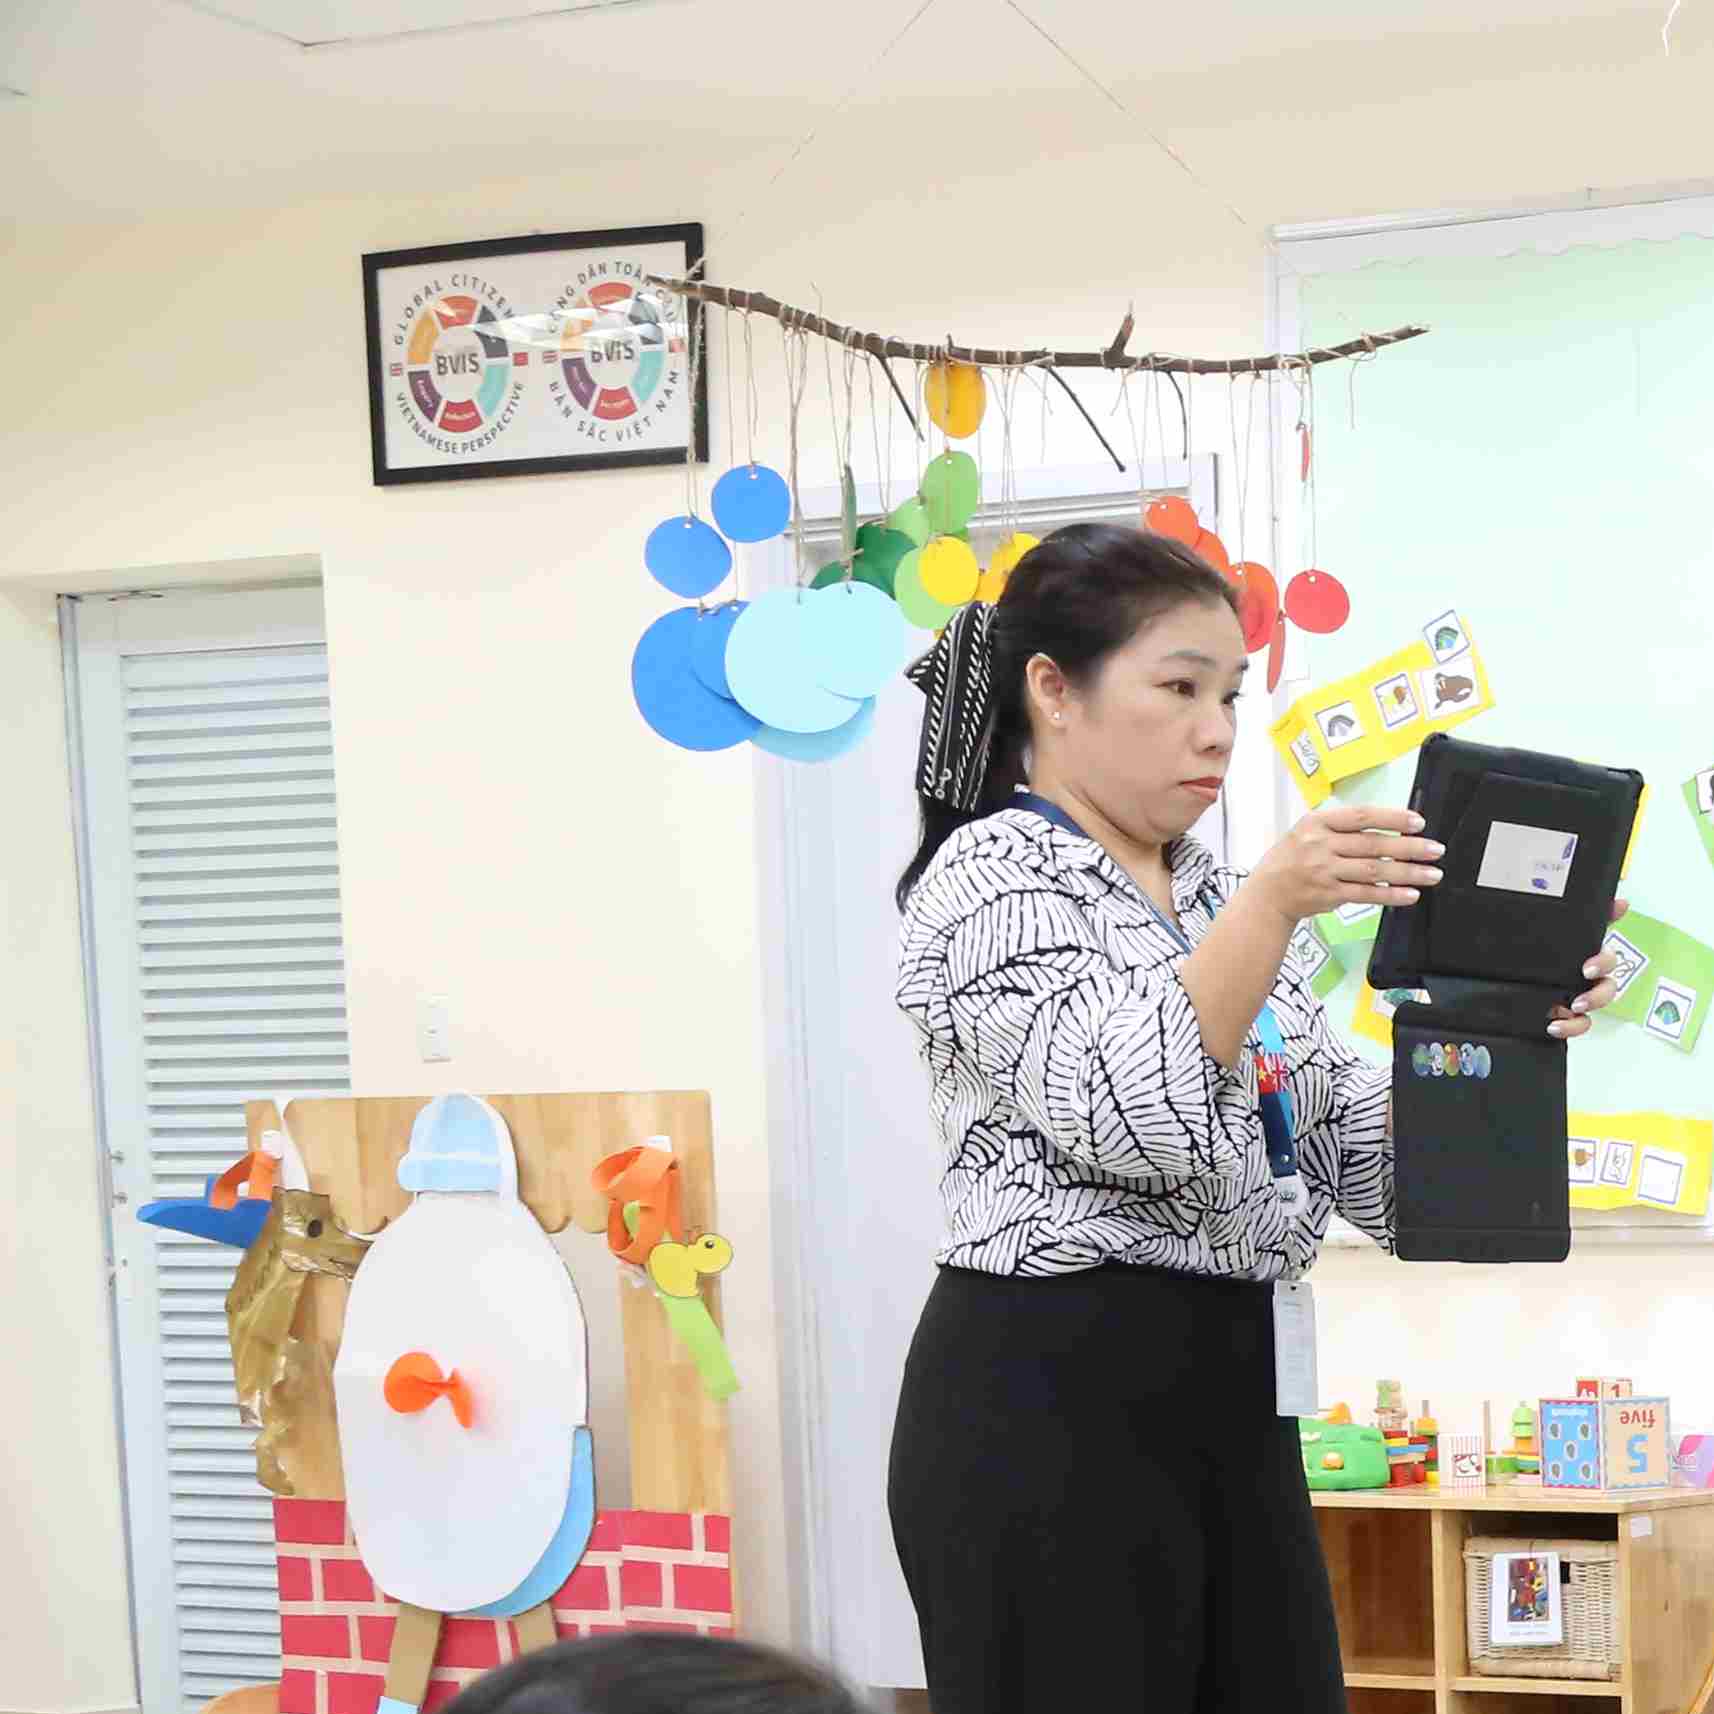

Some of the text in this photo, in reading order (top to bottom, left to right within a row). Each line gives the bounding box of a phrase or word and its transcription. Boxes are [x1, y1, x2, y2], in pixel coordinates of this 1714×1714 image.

[394, 273, 514, 346] GLOBAL CITIZEN
[435, 352, 480, 376] BVIS
[655, 371, 679, 413] NAM
[396, 391, 458, 454] VIETNAMESE
[461, 381, 526, 454] PERSPECTIVE
[1619, 1408, 1656, 1428] five
[1626, 1433, 1649, 1473] 5
